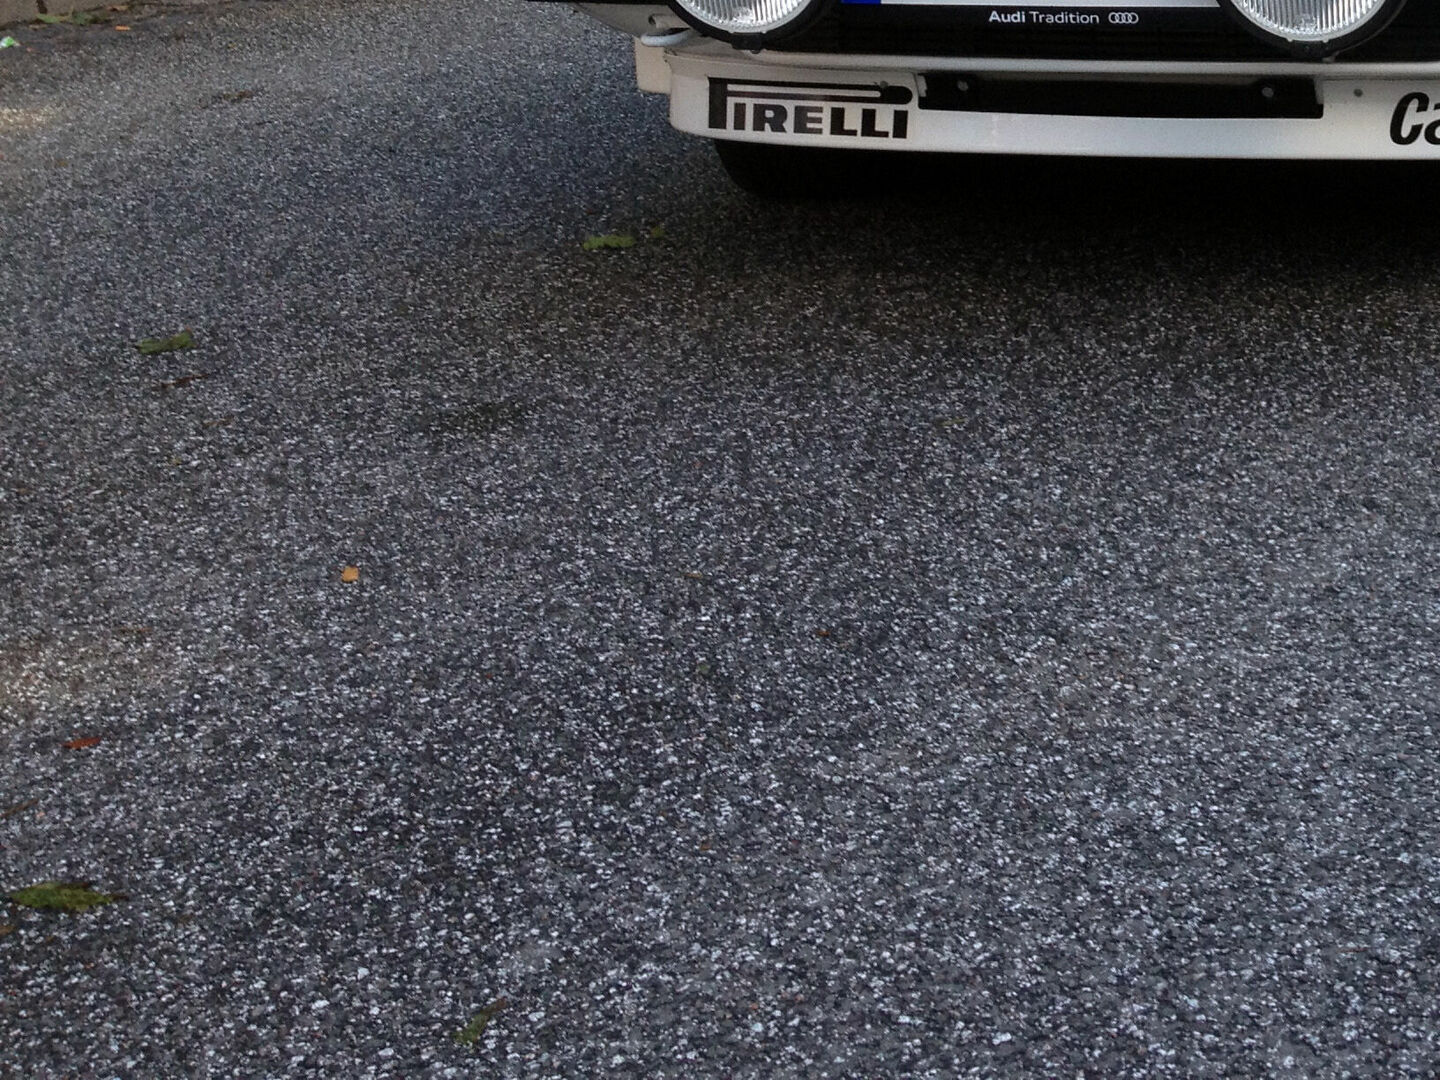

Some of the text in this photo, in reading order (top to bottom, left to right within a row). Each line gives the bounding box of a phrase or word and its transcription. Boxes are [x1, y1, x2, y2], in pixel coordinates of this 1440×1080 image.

[989, 10, 1100, 24] Audi Tradition
[707, 76, 913, 139] PIRELLI
